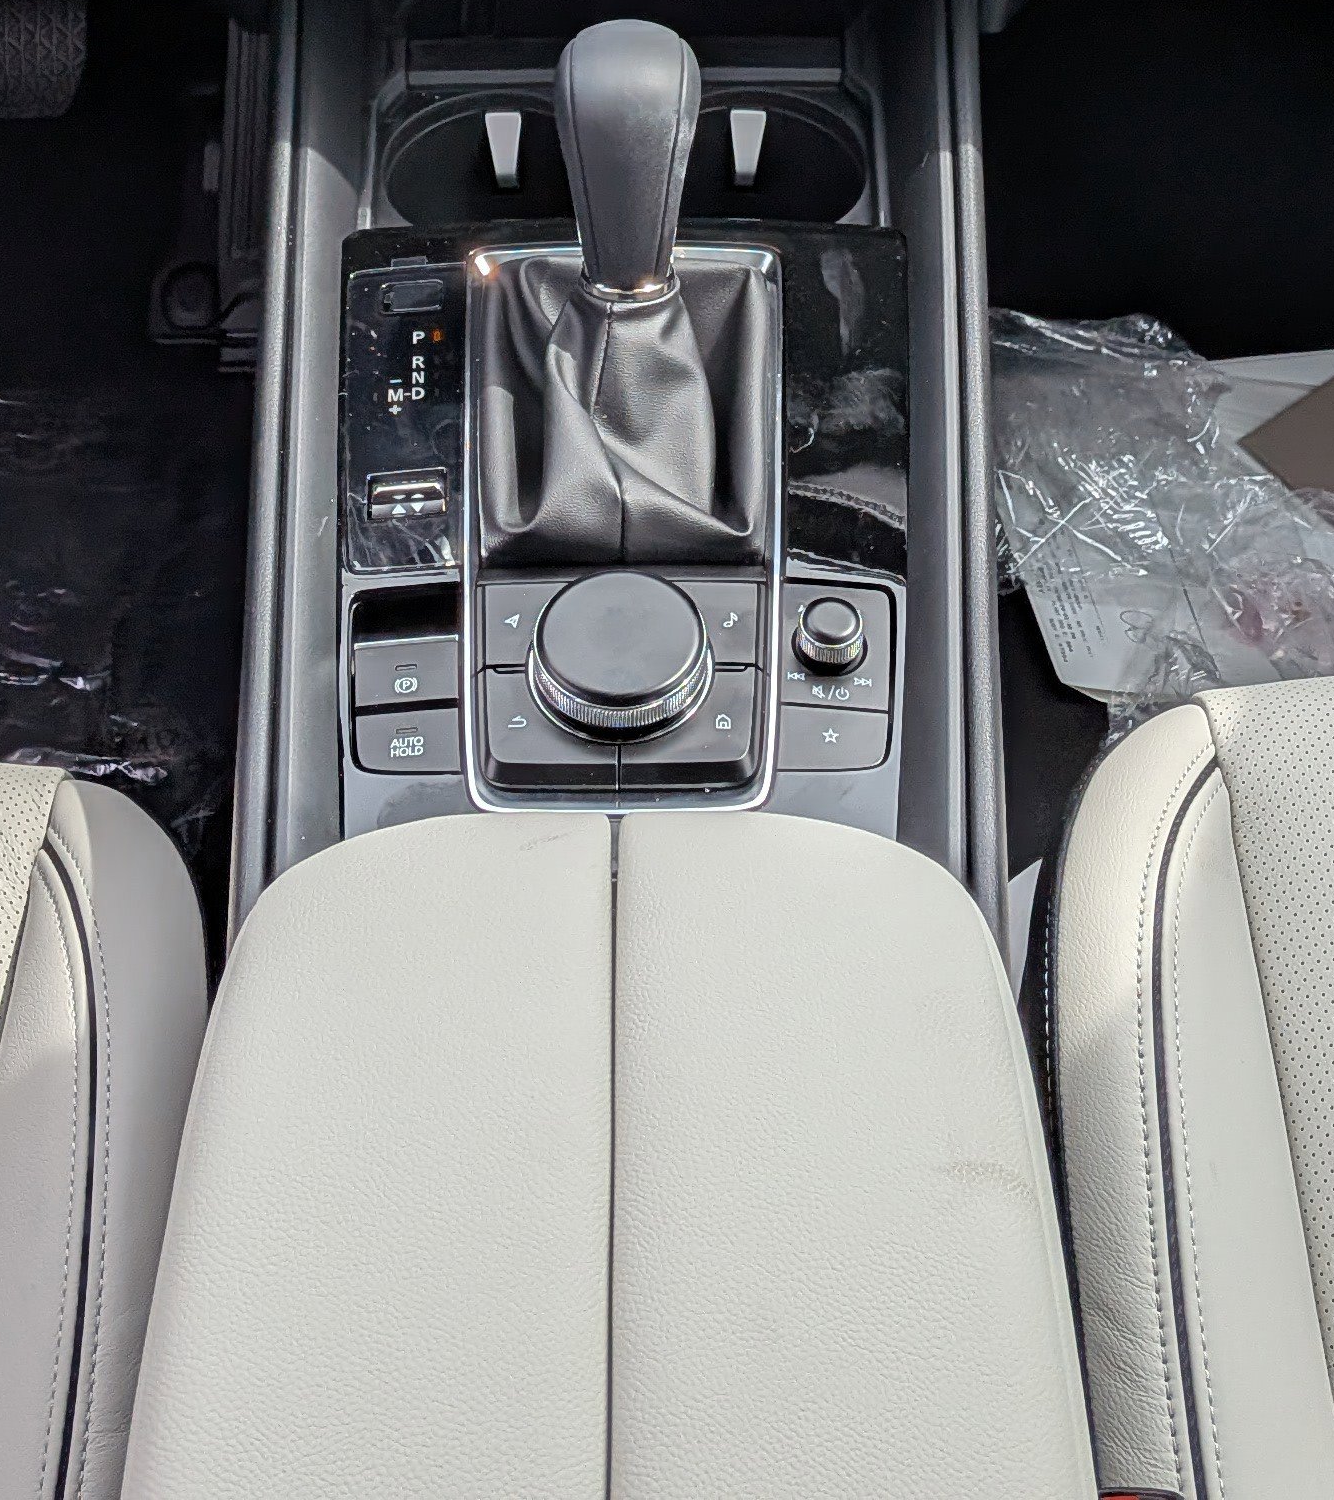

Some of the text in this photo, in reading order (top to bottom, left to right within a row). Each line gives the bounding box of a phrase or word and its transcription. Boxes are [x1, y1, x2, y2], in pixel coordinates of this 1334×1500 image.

[412, 331, 426, 345] P
[412, 356, 426, 369] R
[411, 371, 425, 385] N
[390, 736, 424, 748] AUTO
[390, 746, 424, 757] HOLD
